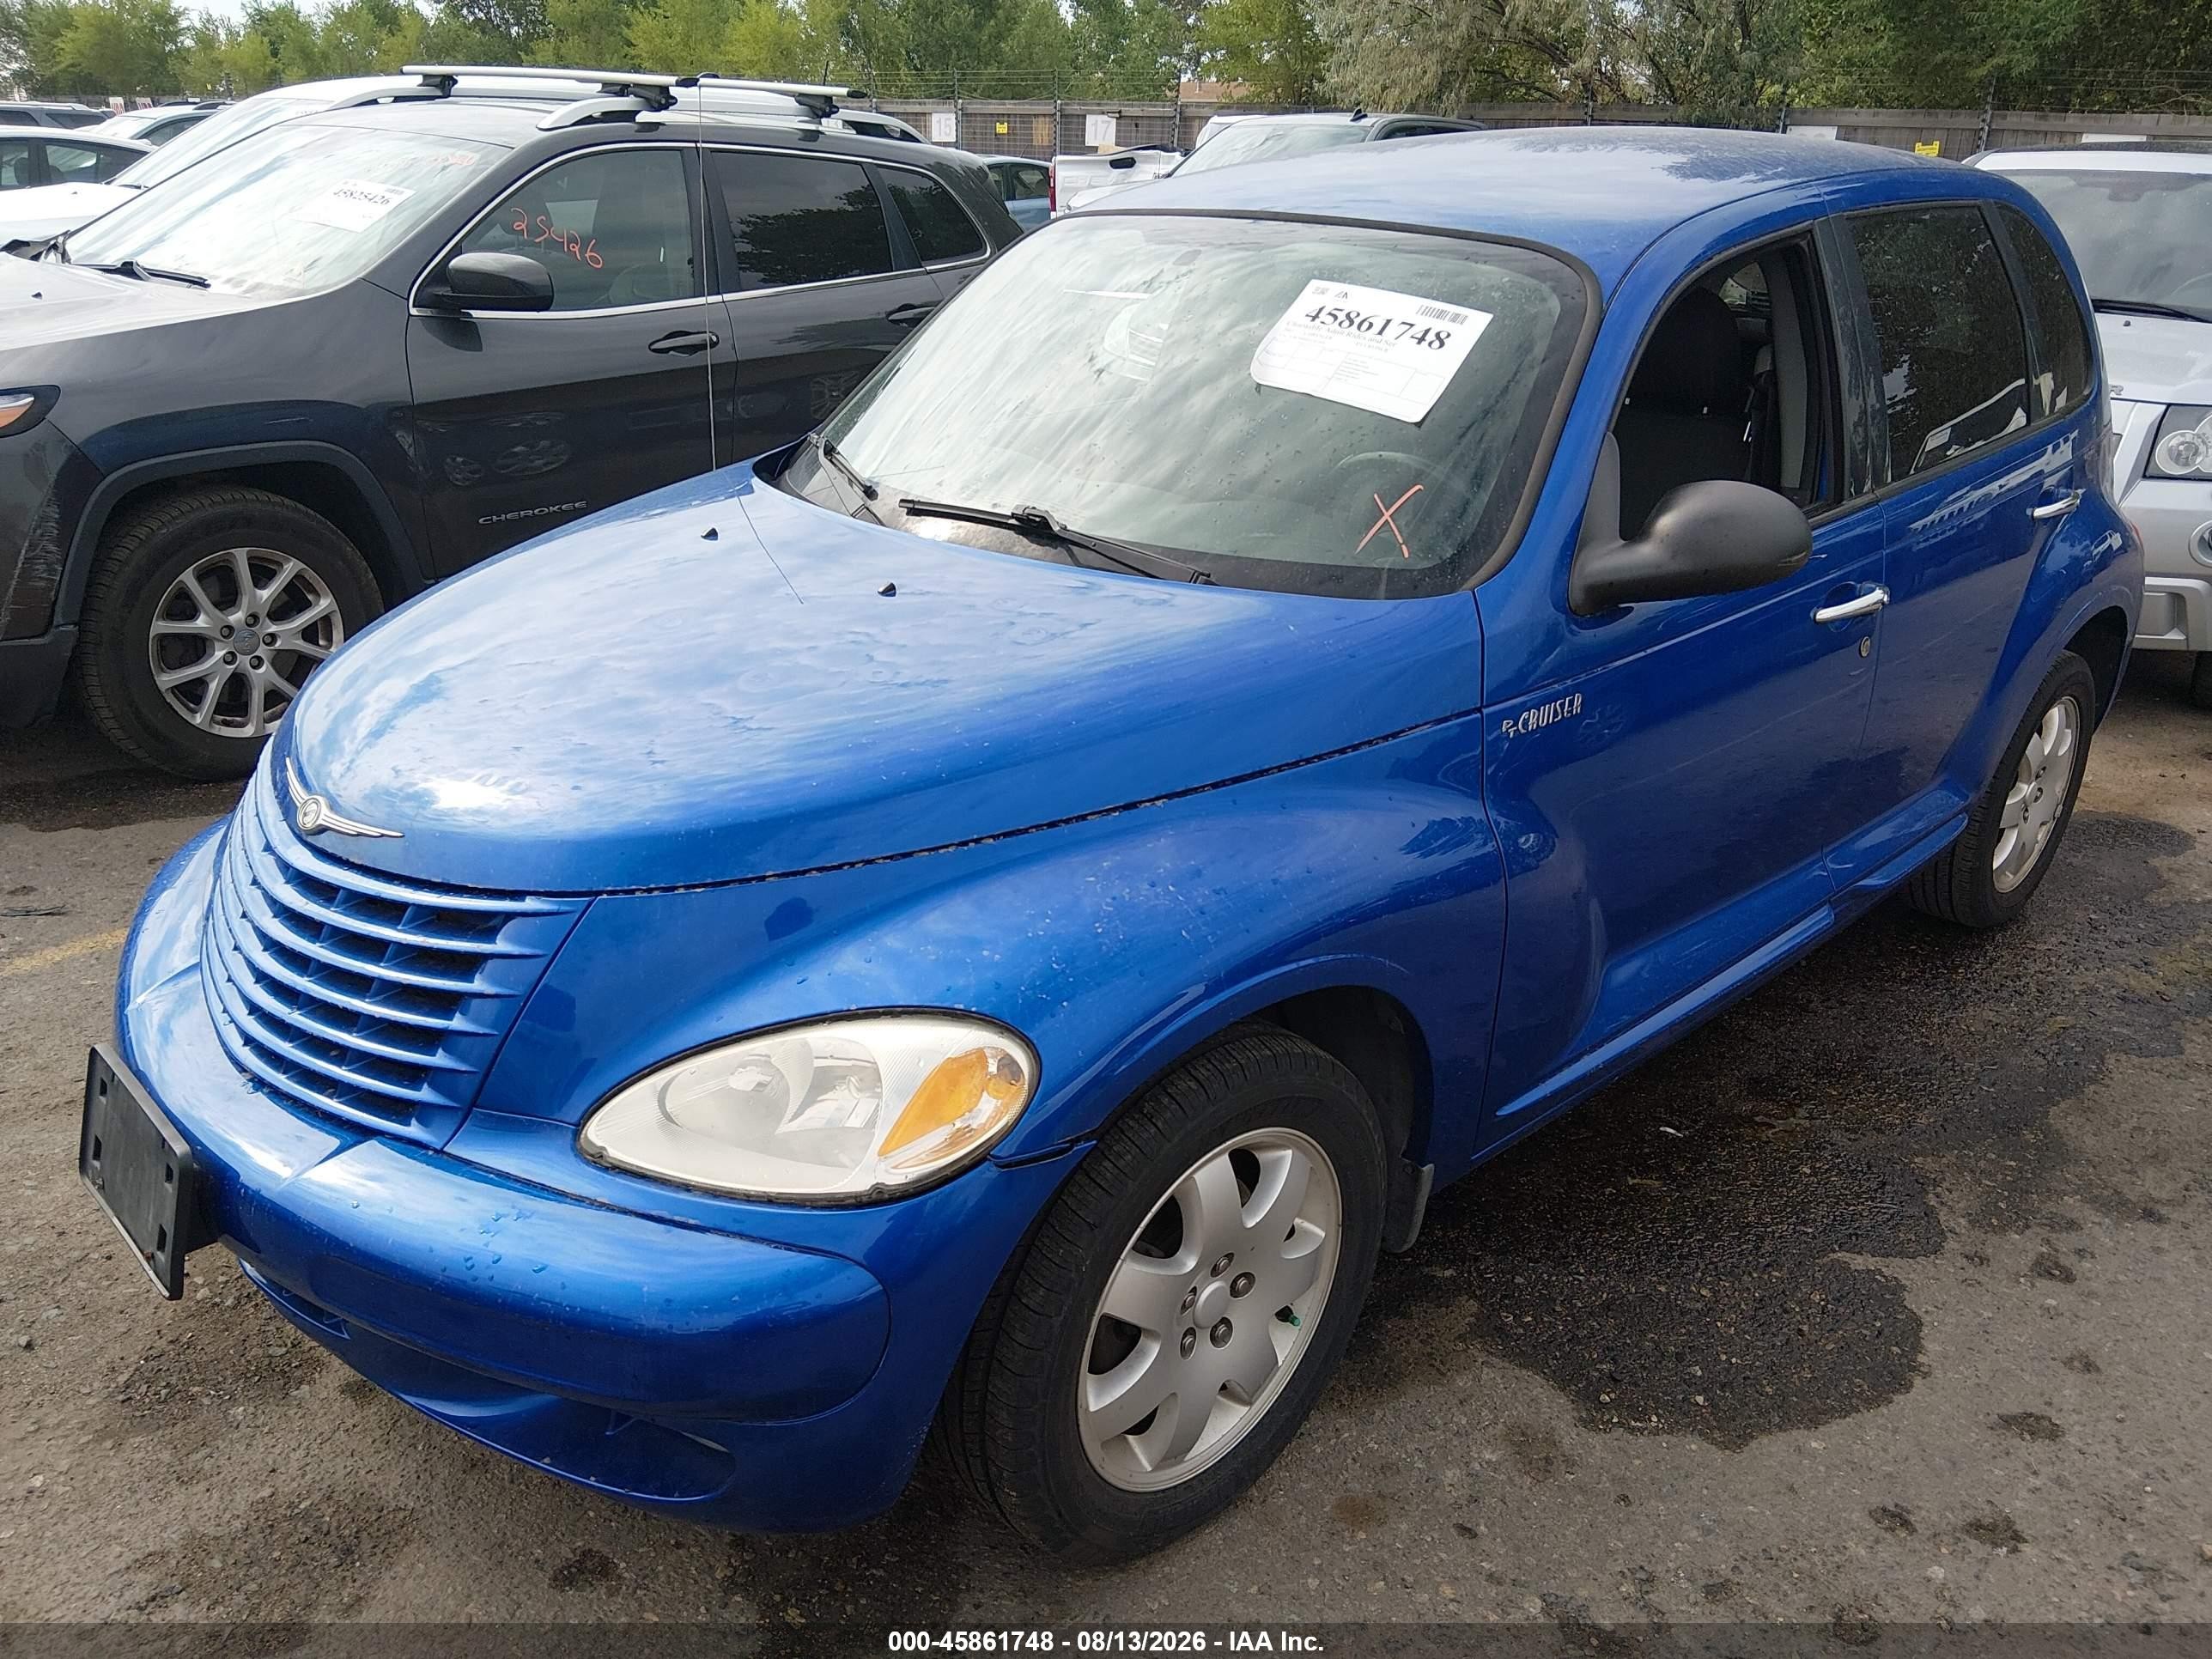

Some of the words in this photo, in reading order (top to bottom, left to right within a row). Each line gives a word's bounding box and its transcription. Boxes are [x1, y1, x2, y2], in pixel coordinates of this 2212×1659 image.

[936, 116, 952, 137] 15
[1091, 119, 1113, 141] 17
[510, 207, 604, 269] 25426
[1304, 305, 1451, 350] 45861748
[478, 501, 587, 524] CHEROKEE
[1502, 720, 1517, 738] PT
[1518, 693, 1582, 734] CRUISER
